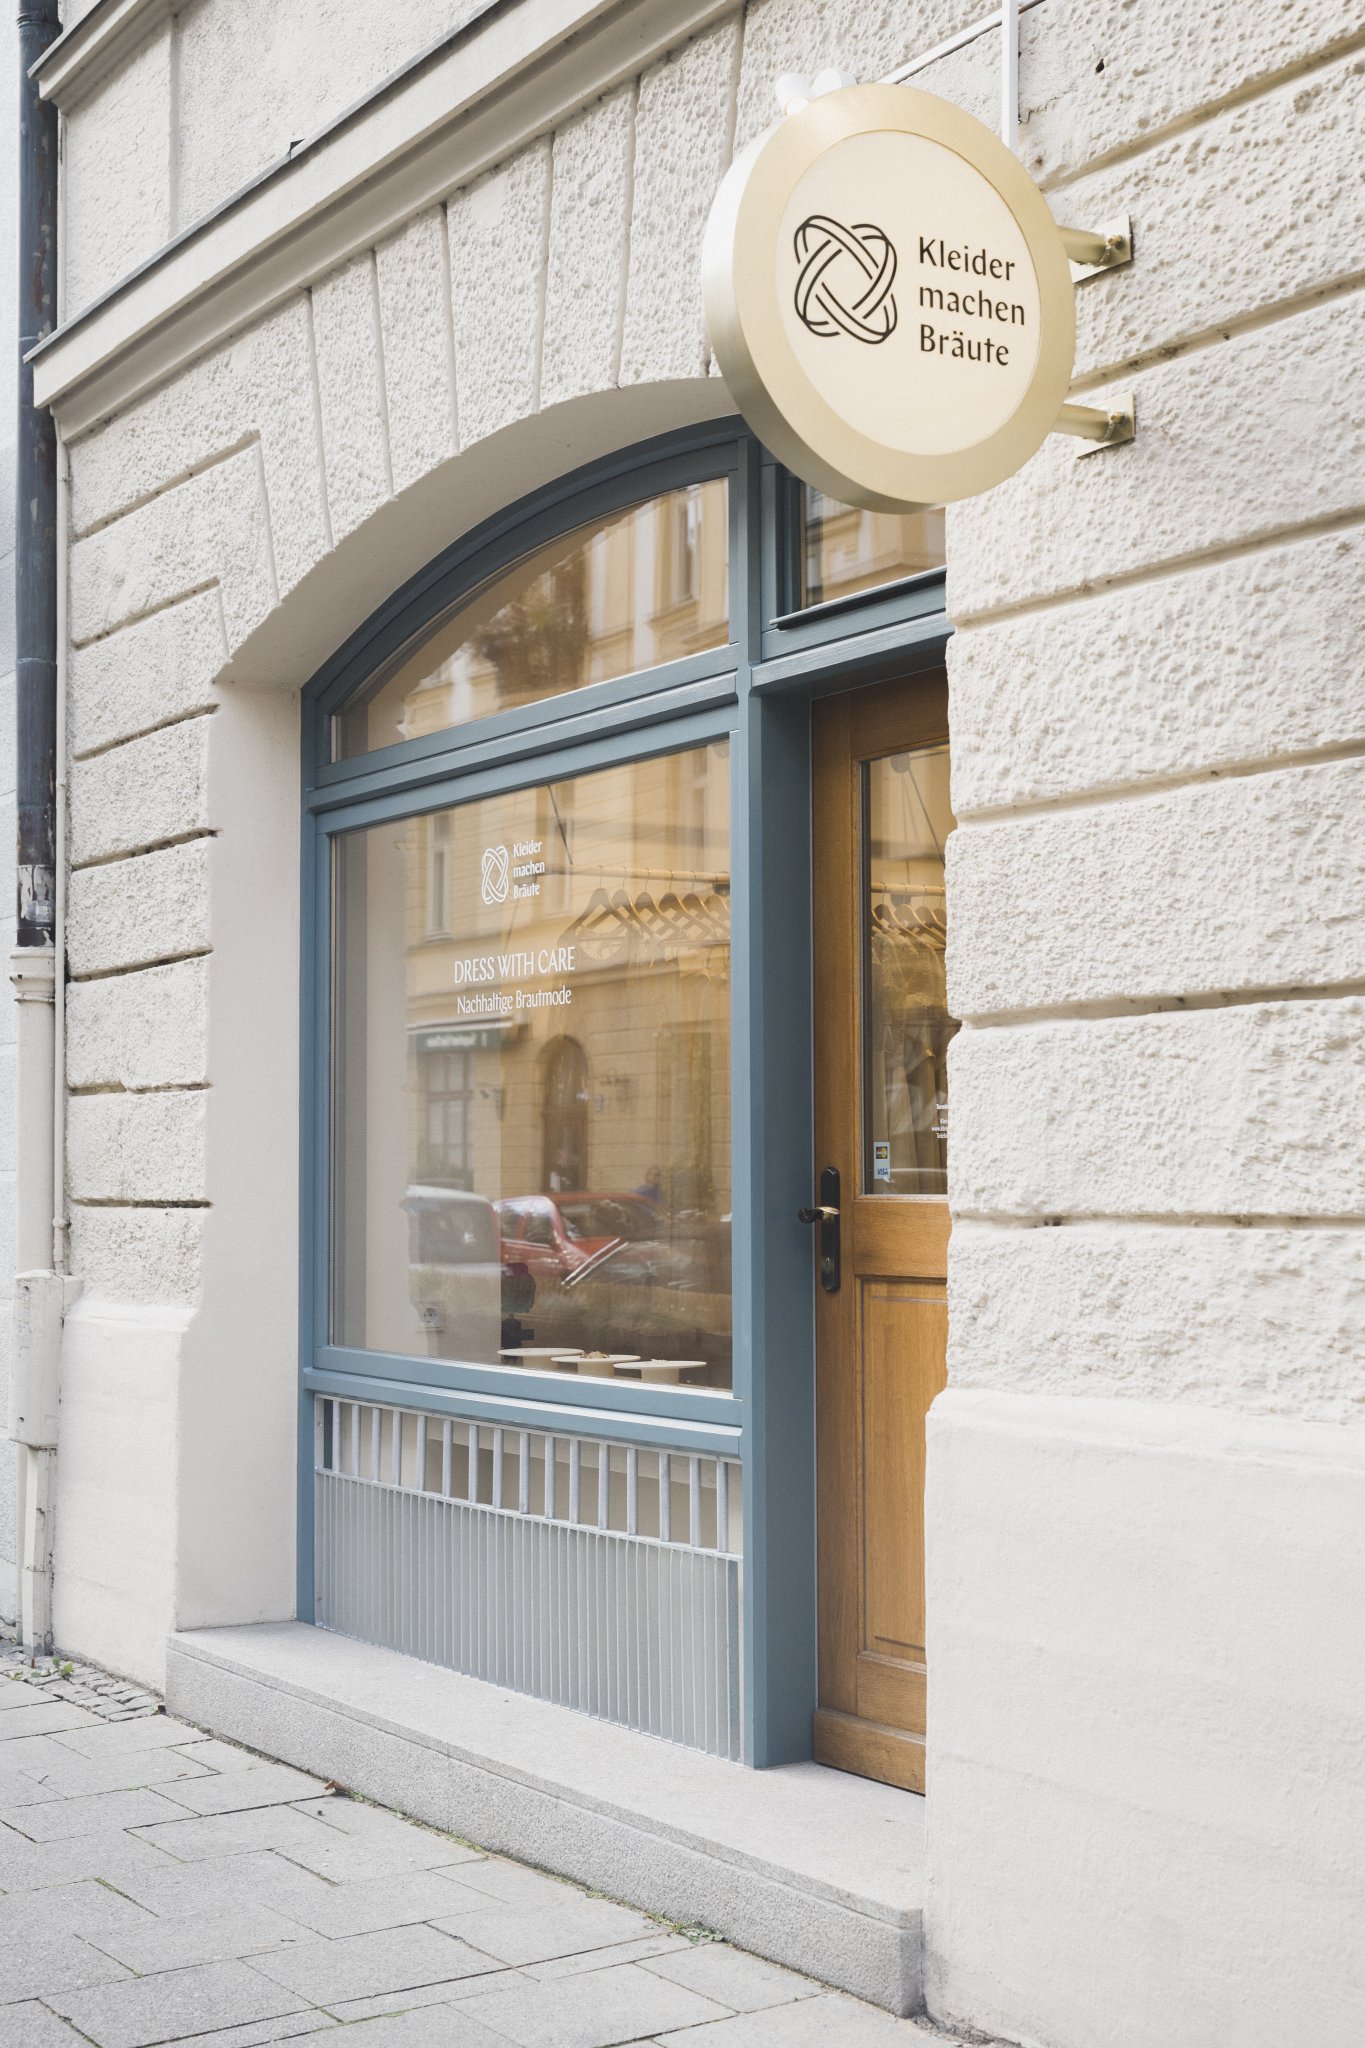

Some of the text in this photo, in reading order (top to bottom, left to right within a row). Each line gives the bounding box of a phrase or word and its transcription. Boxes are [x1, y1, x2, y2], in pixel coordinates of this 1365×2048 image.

[919, 236, 1015, 281] Kleider
[919, 286, 1025, 326] machen
[920, 323, 1009, 366] Bräute
[513, 840, 542, 858] Kleider
[513, 861, 545, 878] machen
[513, 883, 540, 900] Bräute
[454, 946, 576, 983] DRESS WITH CARE
[457, 985, 572, 1015] Nachhaltige Brautmode
